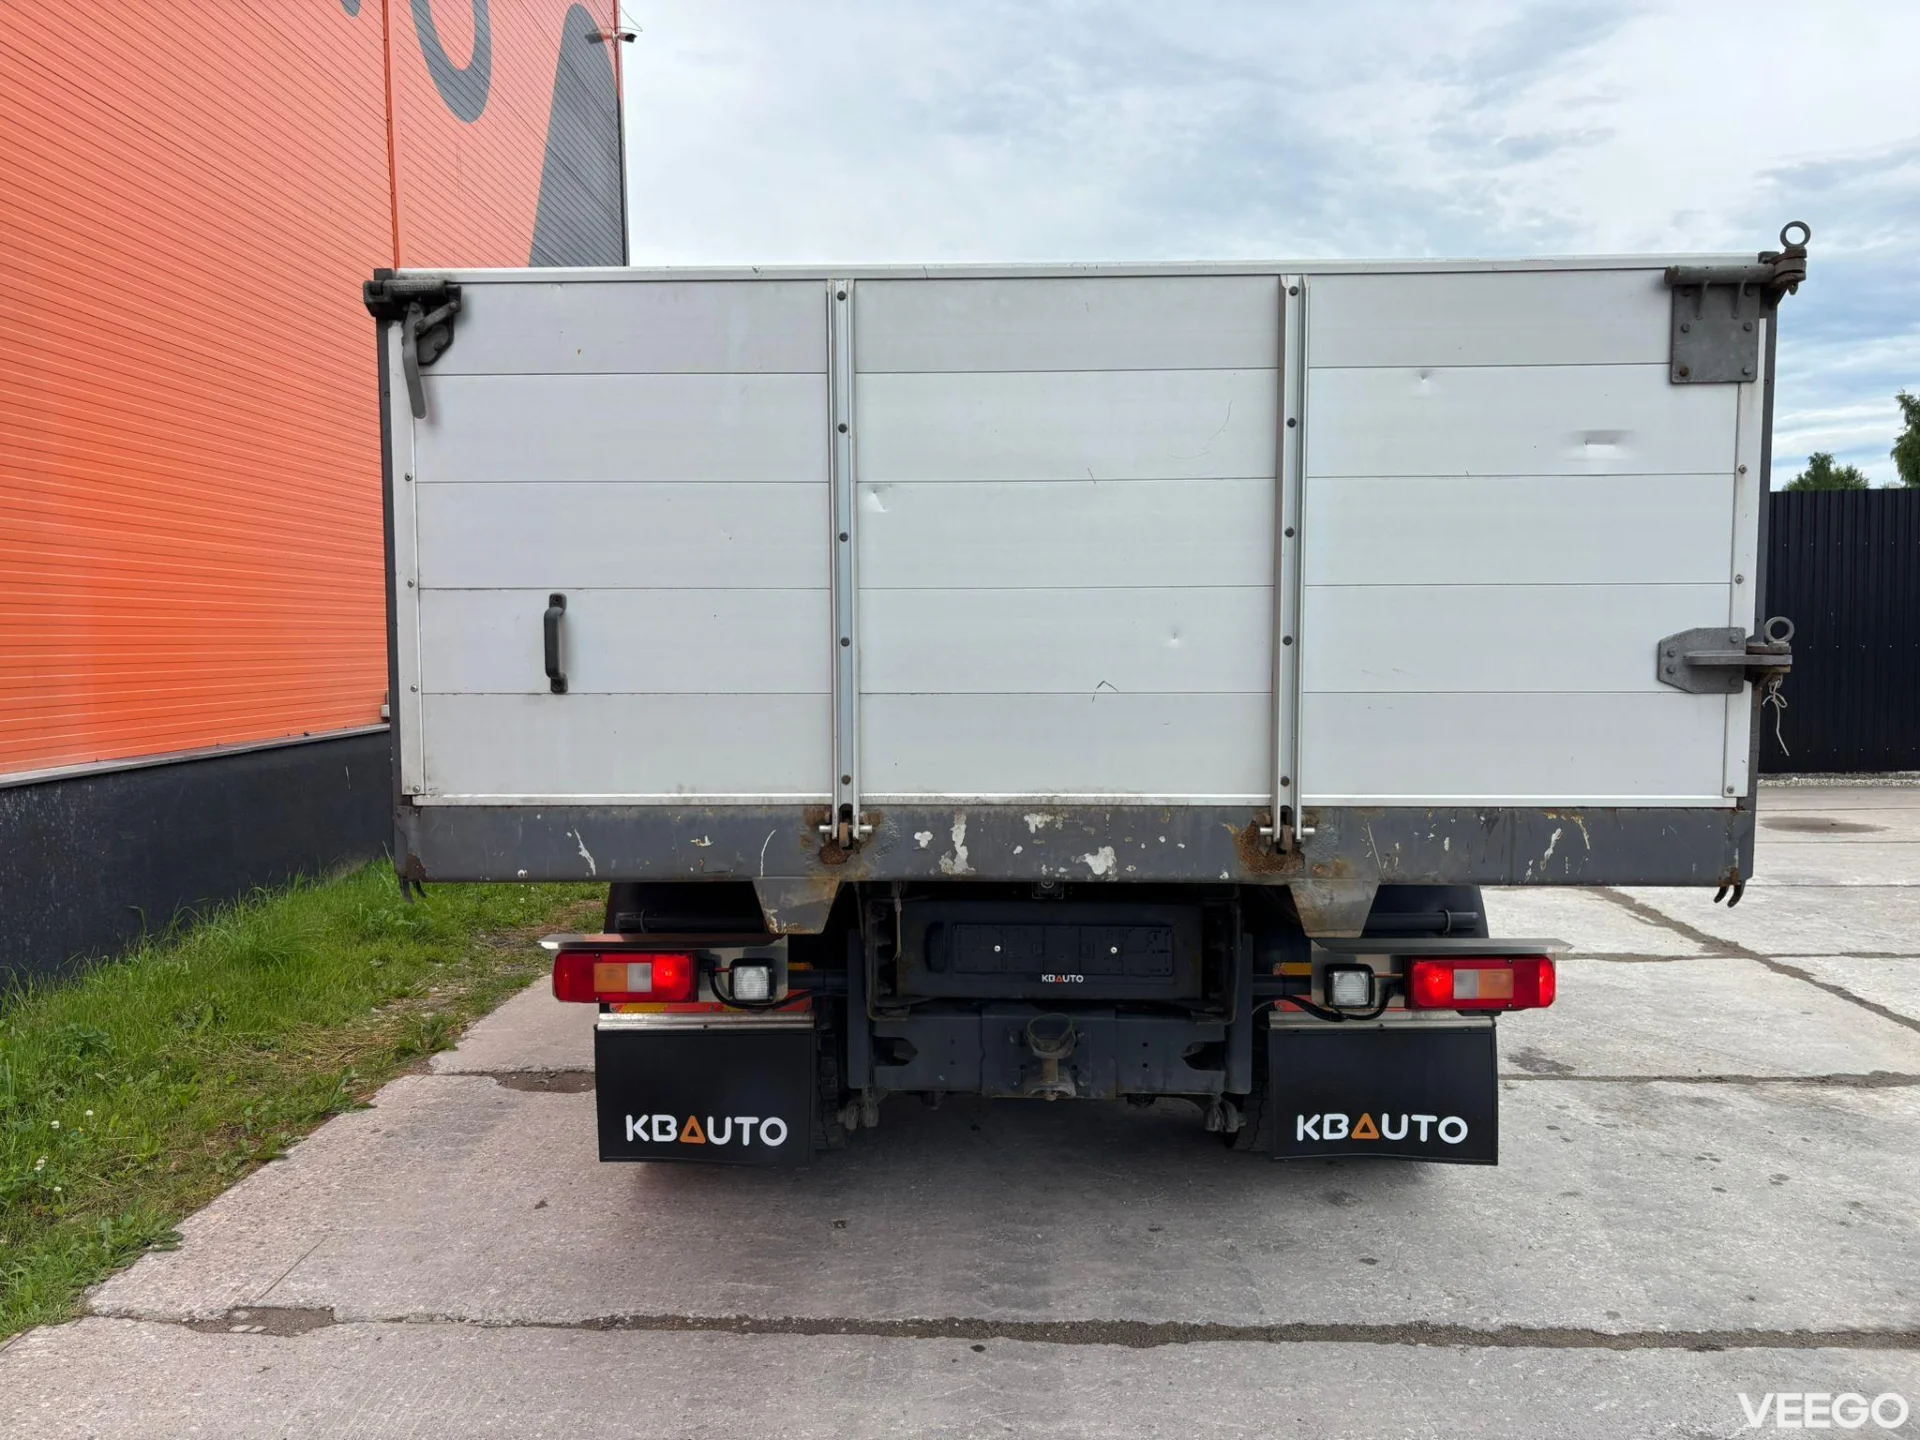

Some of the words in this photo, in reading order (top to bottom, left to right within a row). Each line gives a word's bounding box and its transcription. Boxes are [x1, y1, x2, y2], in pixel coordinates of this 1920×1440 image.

[1041, 974, 1084, 983] KBAUTO
[625, 1114, 788, 1147] KBAUTO
[1296, 1112, 1468, 1144] KBAUTO
